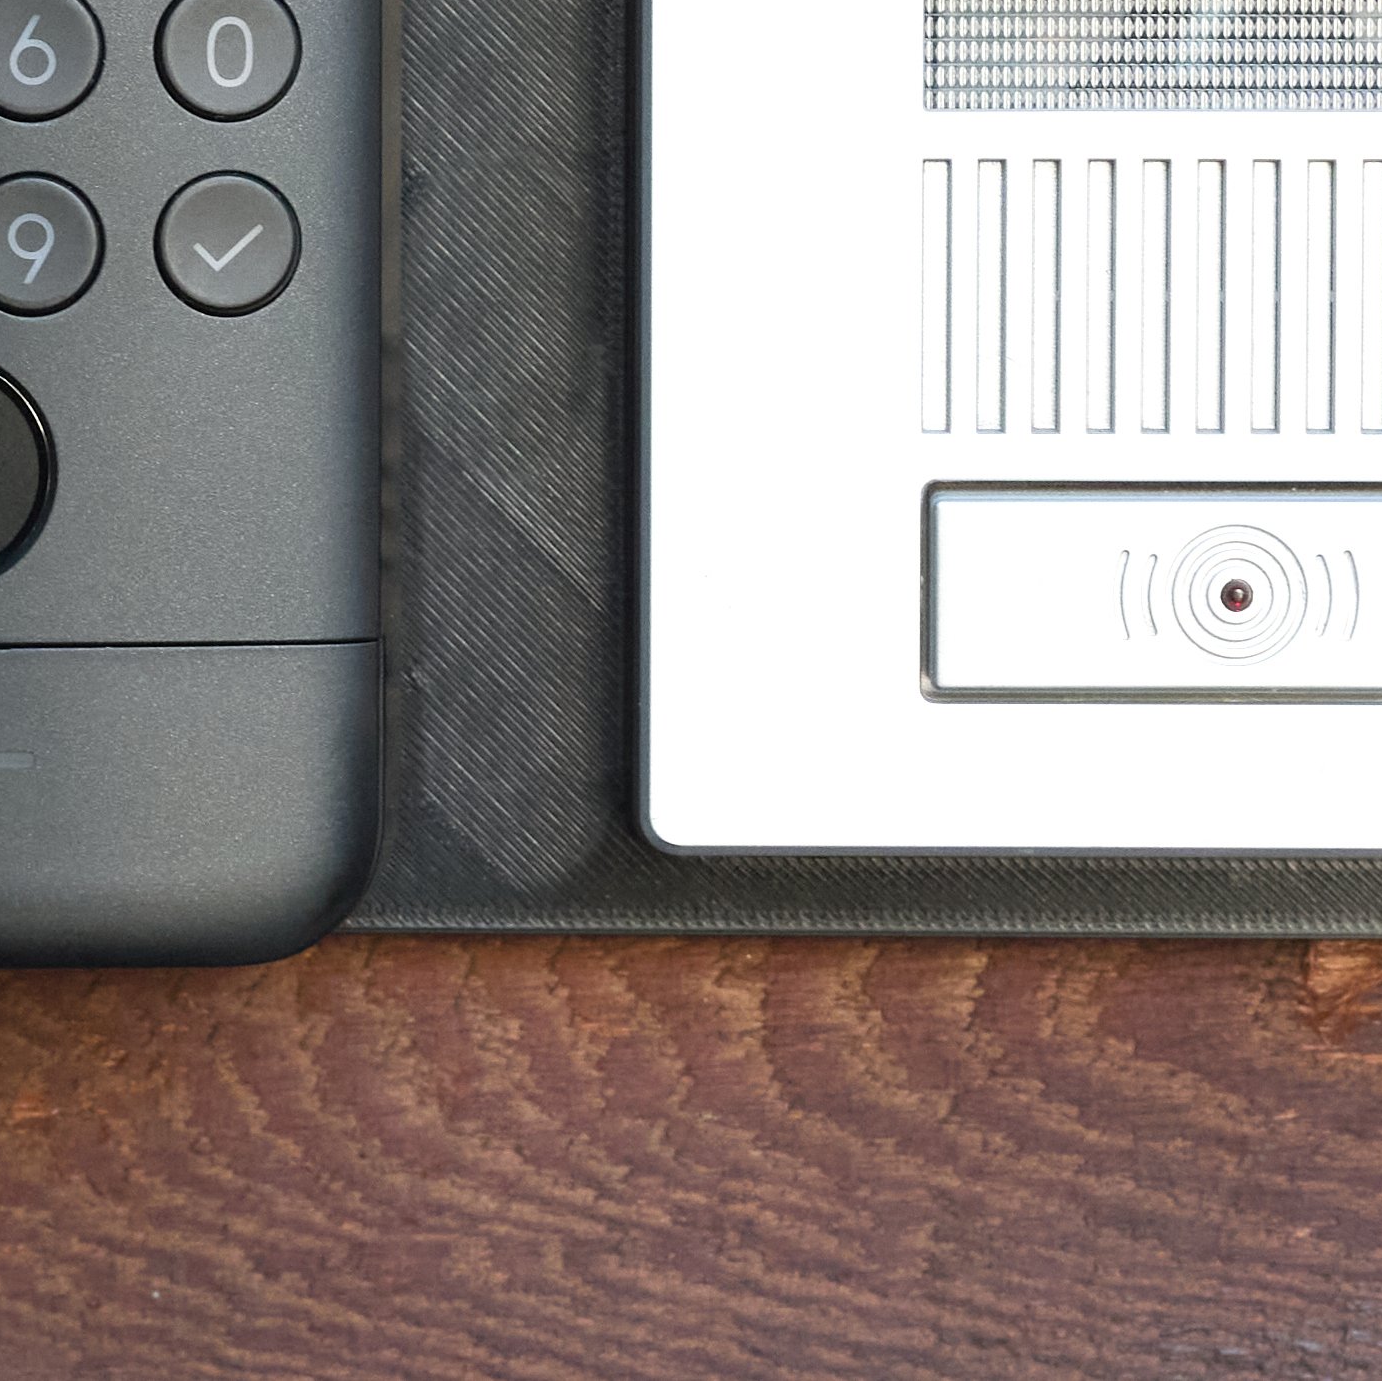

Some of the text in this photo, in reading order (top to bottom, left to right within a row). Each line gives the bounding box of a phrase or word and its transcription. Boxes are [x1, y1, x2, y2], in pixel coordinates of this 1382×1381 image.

[9, 15, 57, 86] 6
[206, 16, 254, 88] 0
[7, 213, 55, 285] 9
